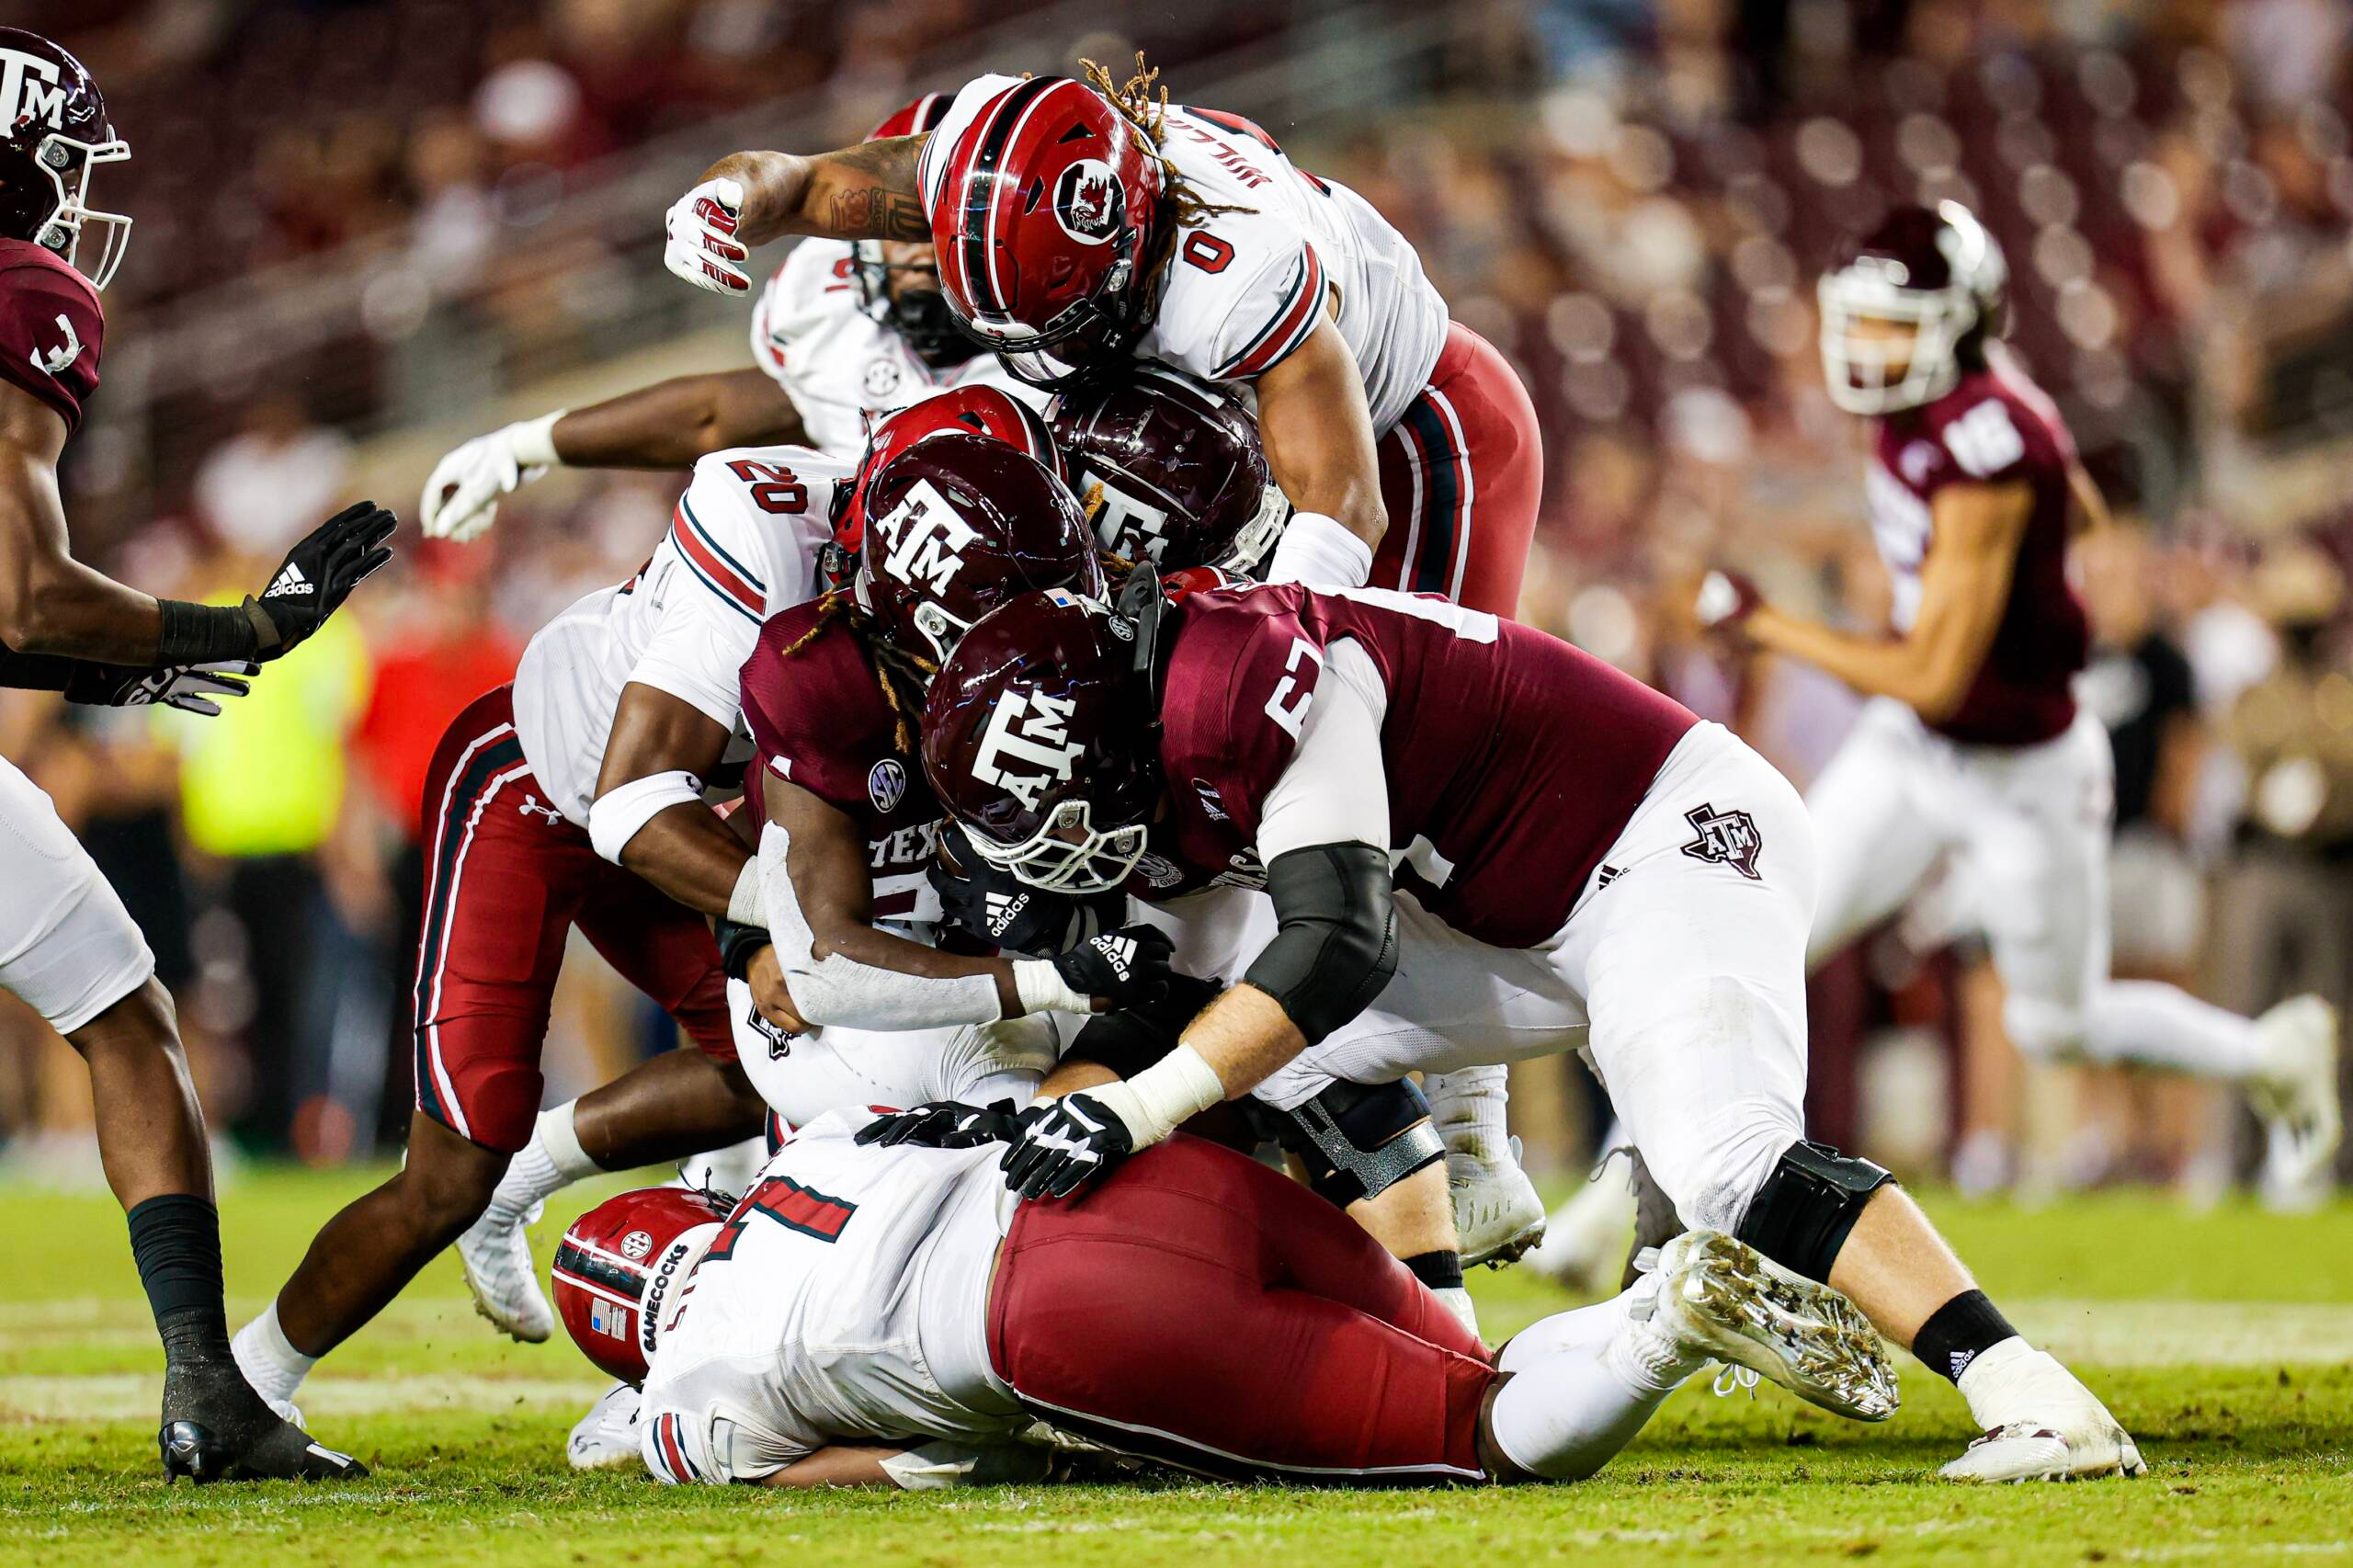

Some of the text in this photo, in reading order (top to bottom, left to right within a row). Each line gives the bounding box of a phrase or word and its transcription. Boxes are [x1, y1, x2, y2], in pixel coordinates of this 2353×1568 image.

[1183, 230, 1235, 275] 0
[724, 460, 809, 515] 20
[265, 582, 314, 597] adidas
[871, 762, 904, 810] SEC
[991, 892, 1029, 937] adidas
[1089, 936, 1131, 983] adidas
[621, 1231, 653, 1259] SEC
[643, 1243, 689, 1353] GAMECOCKS
